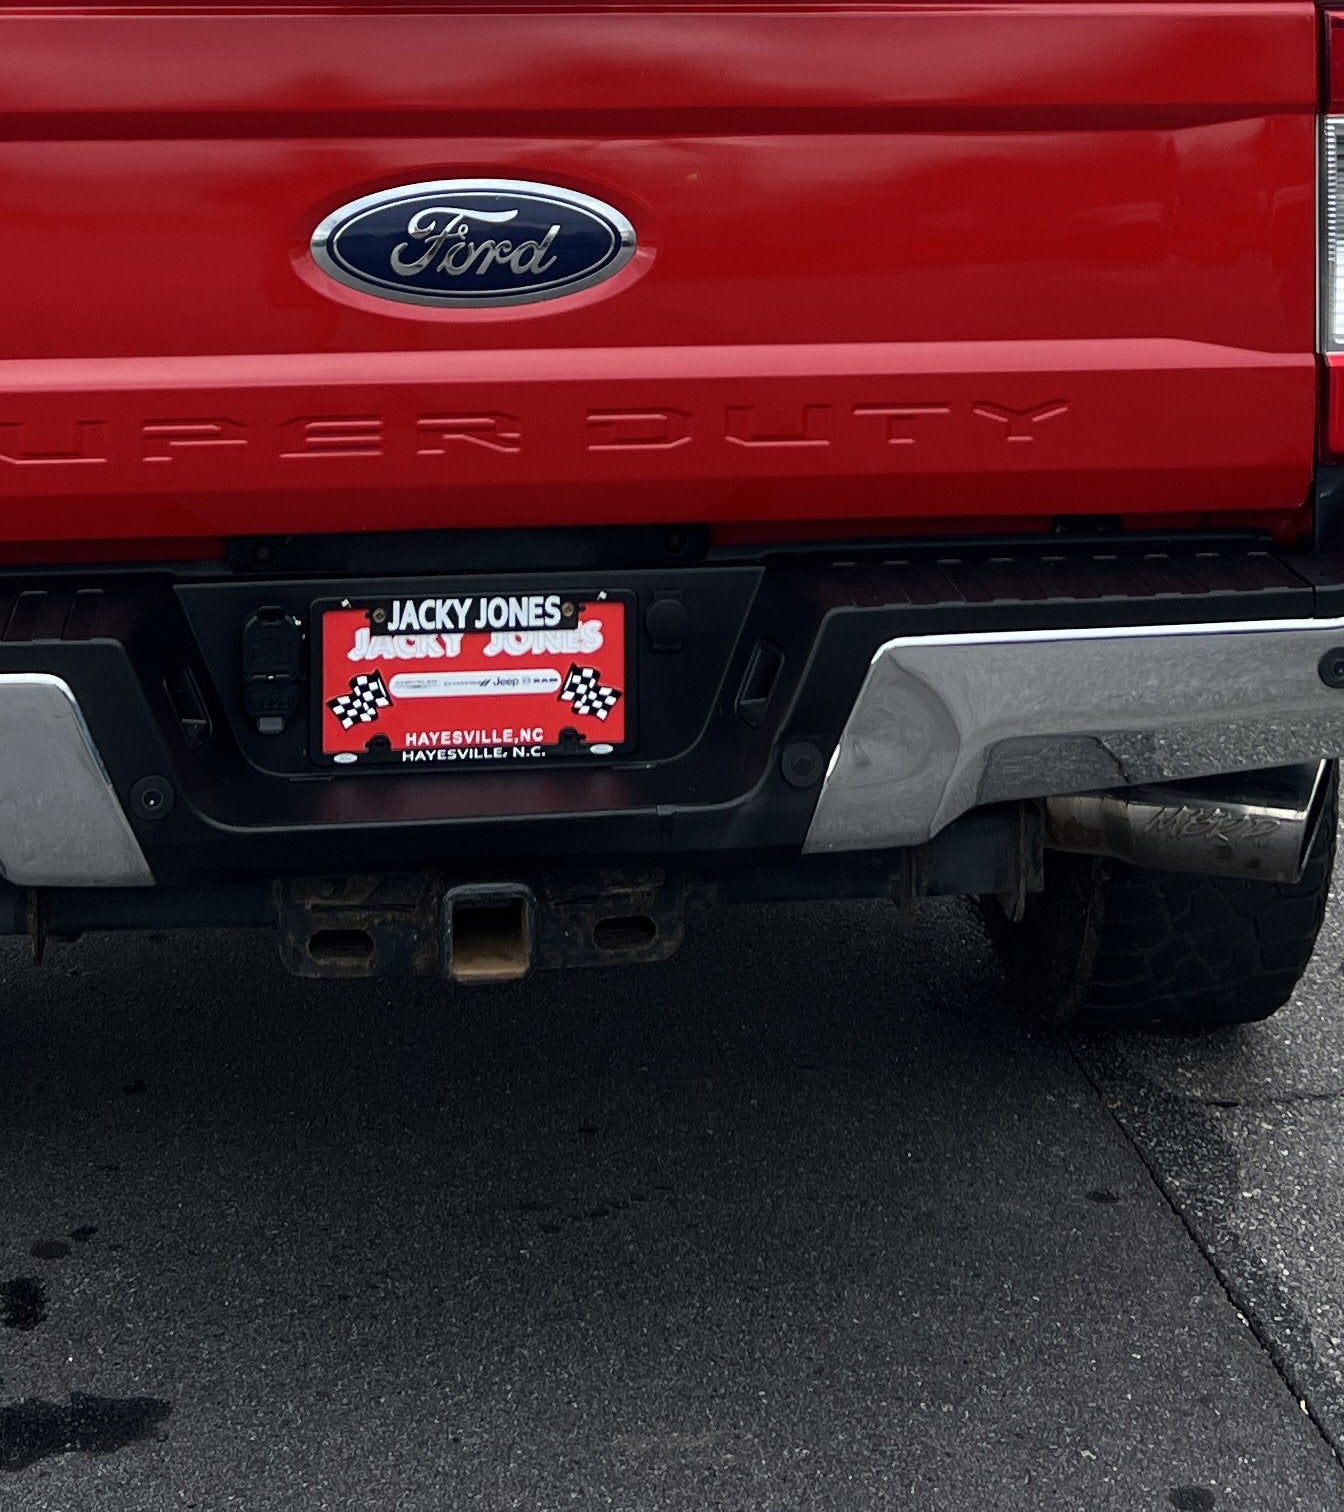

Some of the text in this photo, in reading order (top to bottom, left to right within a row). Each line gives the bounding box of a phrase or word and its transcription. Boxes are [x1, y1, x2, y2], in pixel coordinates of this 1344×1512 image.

[390, 206, 561, 277] Ford
[586, 399, 1069, 451] DUTY
[387, 595, 562, 632] JACKY JONES
[402, 745, 546, 763] HAYESVILLE, N.C.
